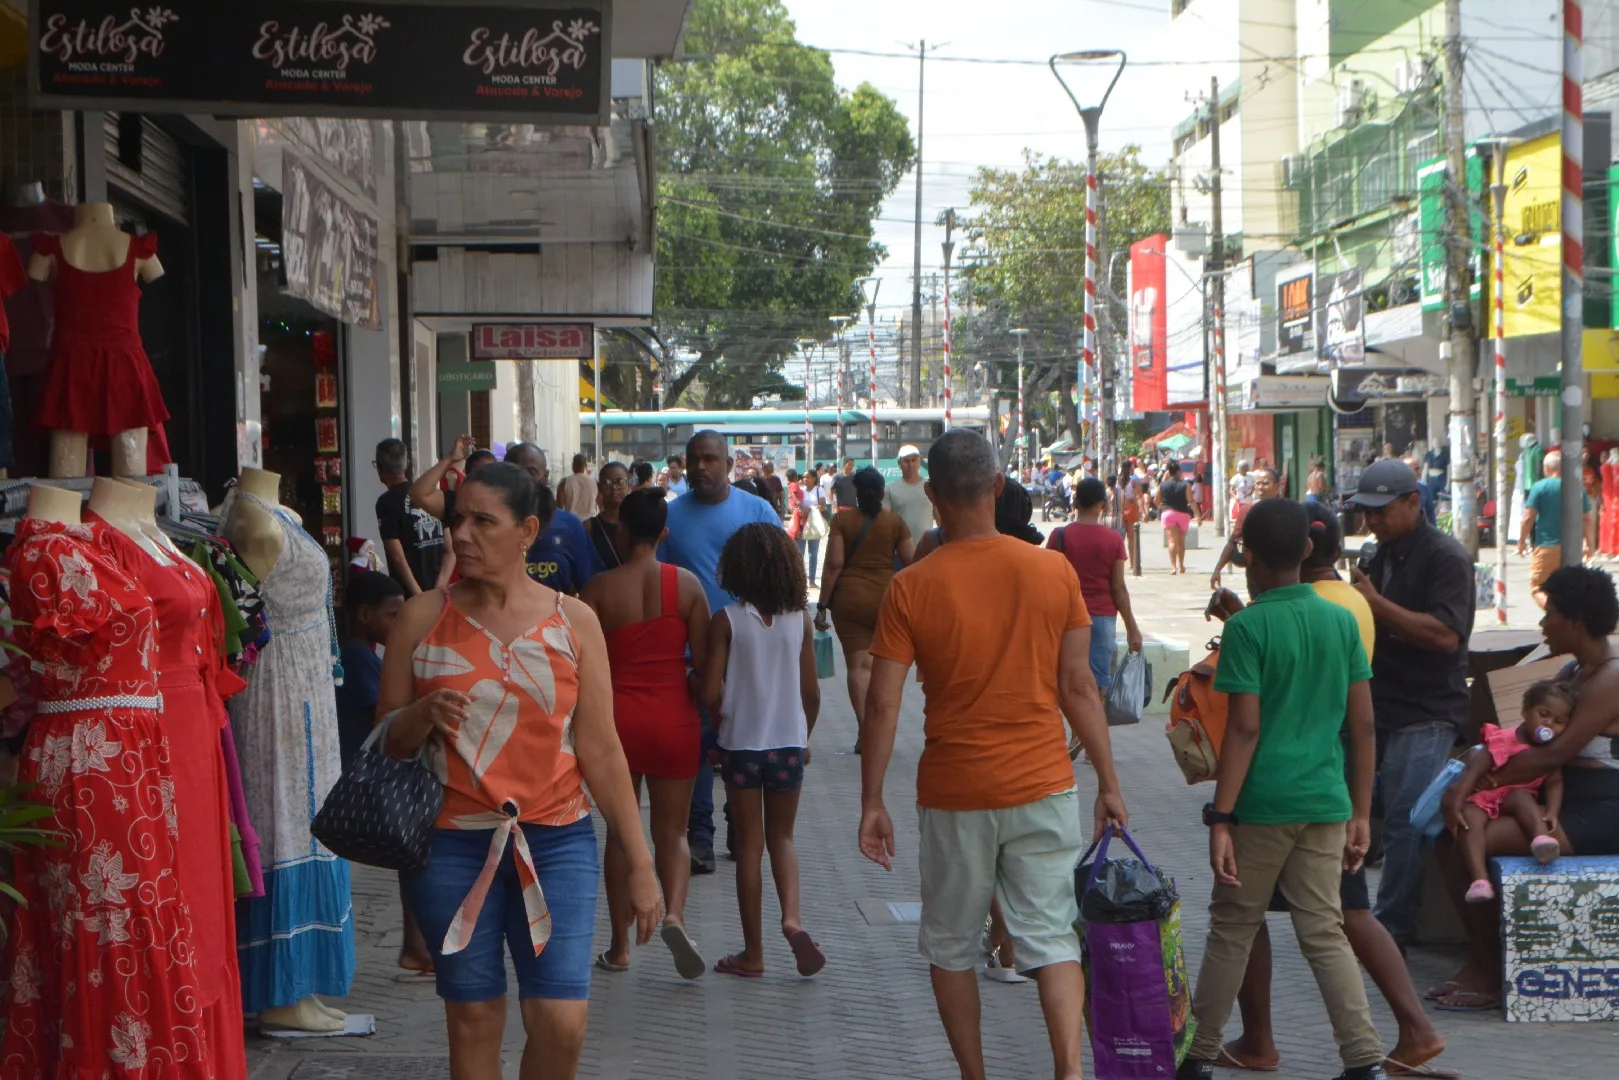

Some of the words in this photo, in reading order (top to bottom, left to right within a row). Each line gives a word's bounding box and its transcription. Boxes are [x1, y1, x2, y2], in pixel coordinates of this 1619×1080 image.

[40, 13, 165, 64] Estilosa
[252, 20, 376, 70] Estilosa
[463, 26, 587, 76] Estilosa
[68, 62, 98, 72] MODA
[99, 62, 135, 73] CENTER
[281, 68, 310, 78] MODA
[312, 69, 346, 79] CENTER
[491, 75, 520, 84] MODA
[522, 75, 557, 85] CENTER
[543, 86, 583, 99] Varejo
[482, 326, 582, 349] Laisa
